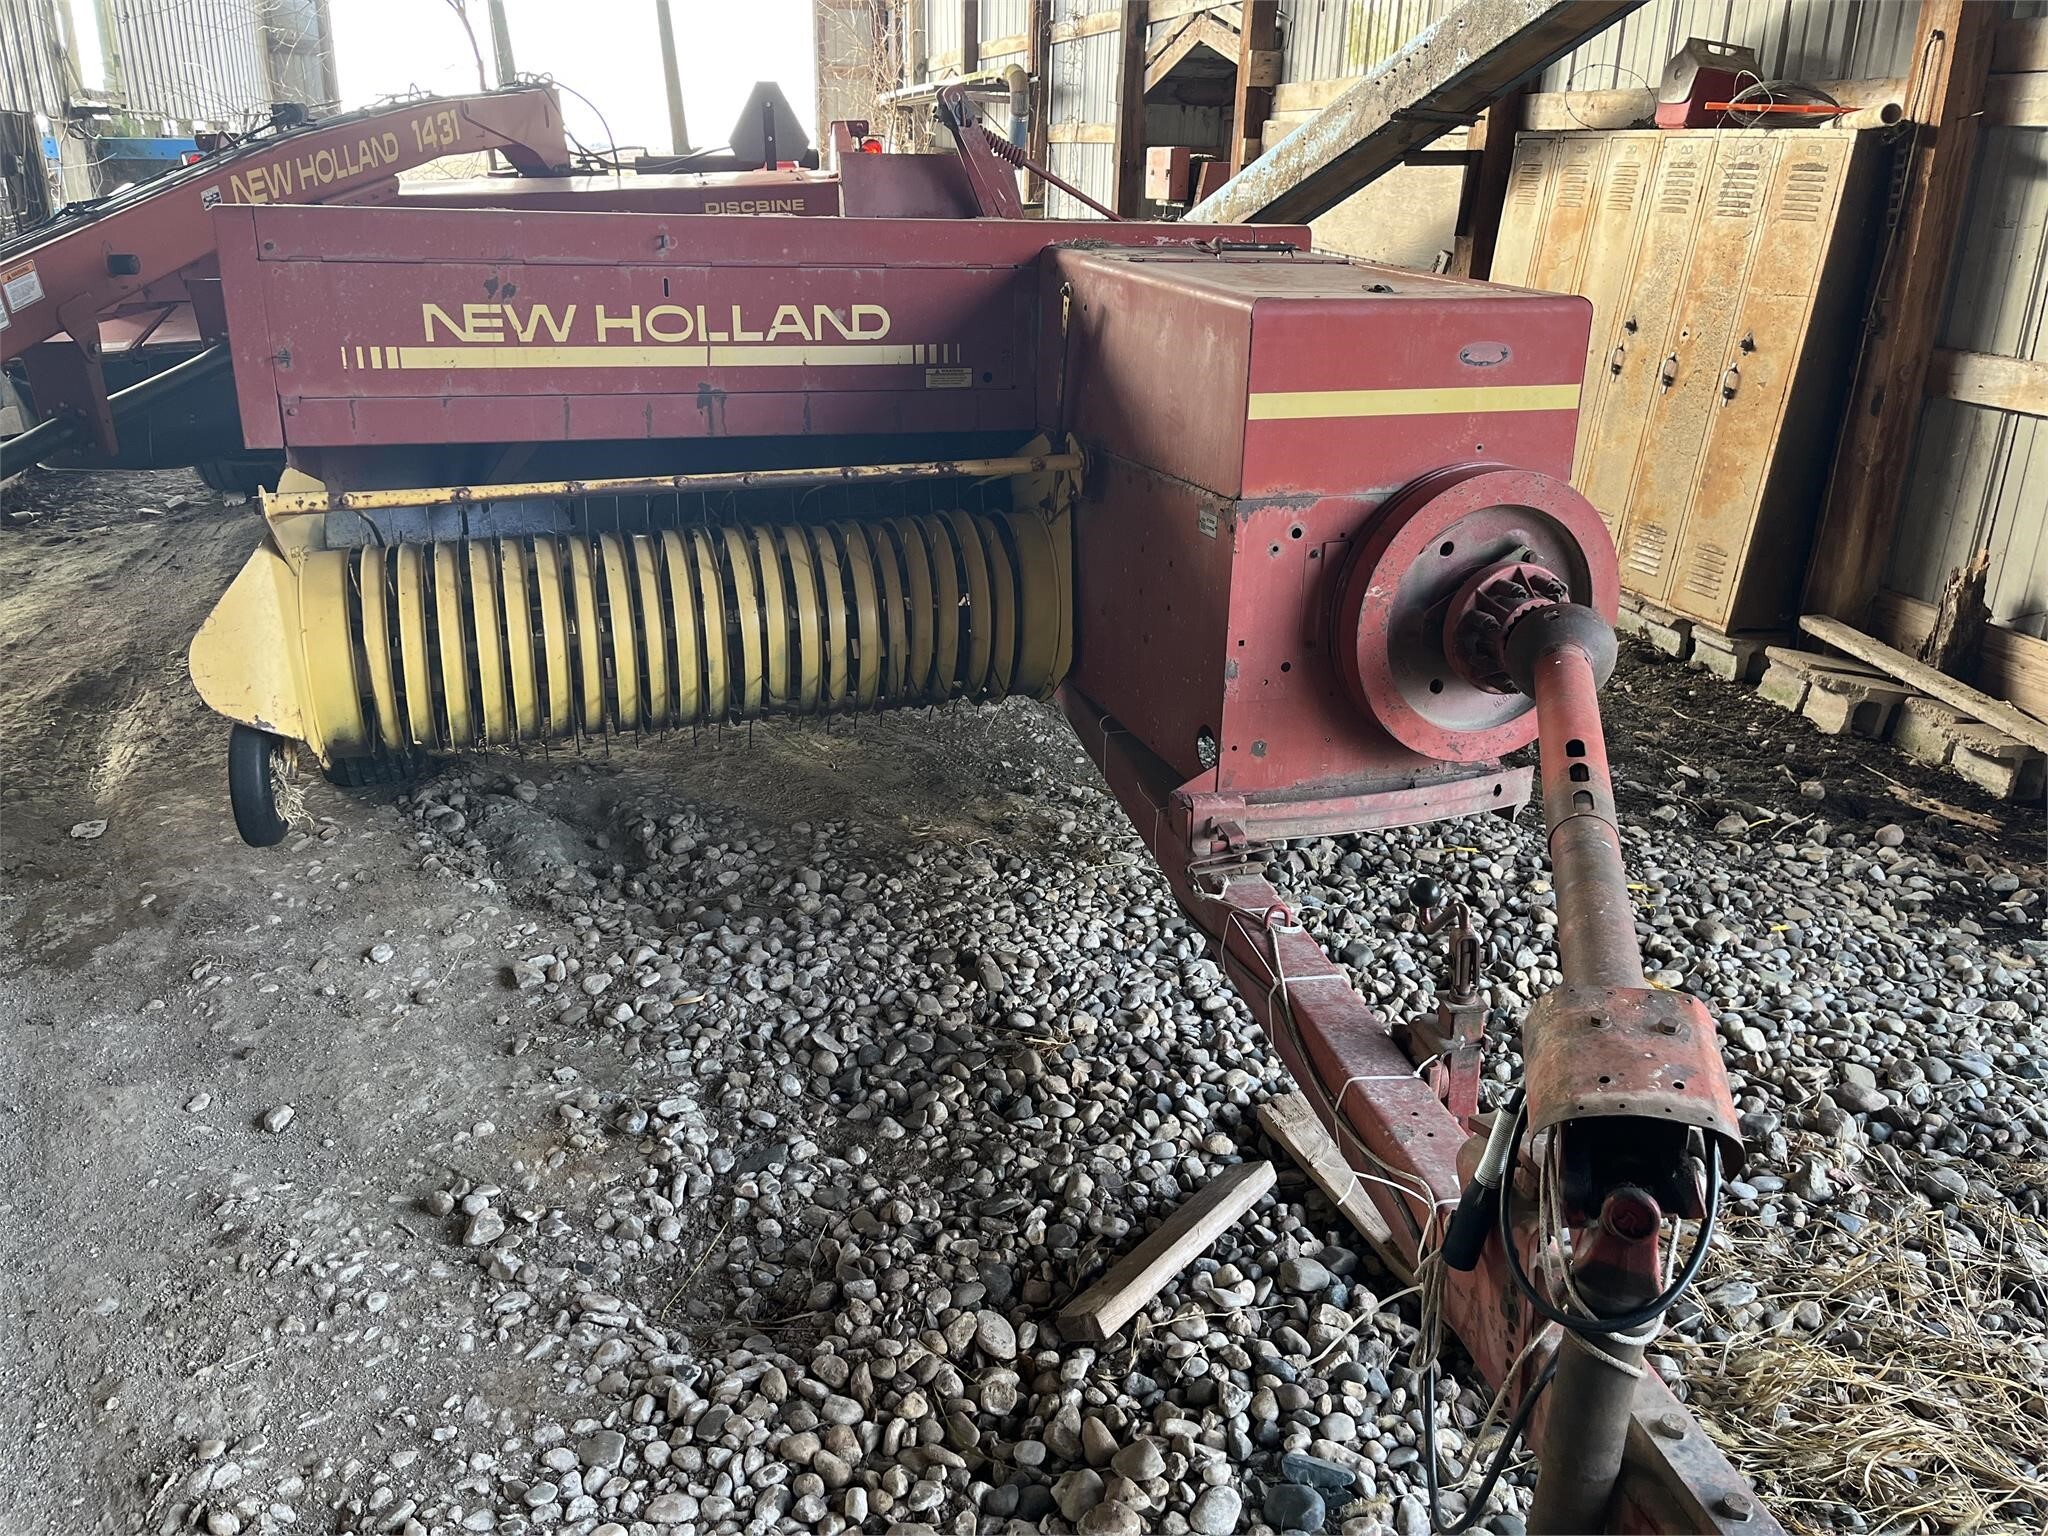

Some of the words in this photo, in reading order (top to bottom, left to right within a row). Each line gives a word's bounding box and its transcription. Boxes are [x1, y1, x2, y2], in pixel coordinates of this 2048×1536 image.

[230, 161, 292, 205] NEW
[296, 132, 399, 190] HOLLAND
[411, 109, 461, 153] 1431
[705, 199, 805, 214] DISCBINE
[422, 303, 577, 343] NEW
[596, 304, 891, 343] HOLLAND
